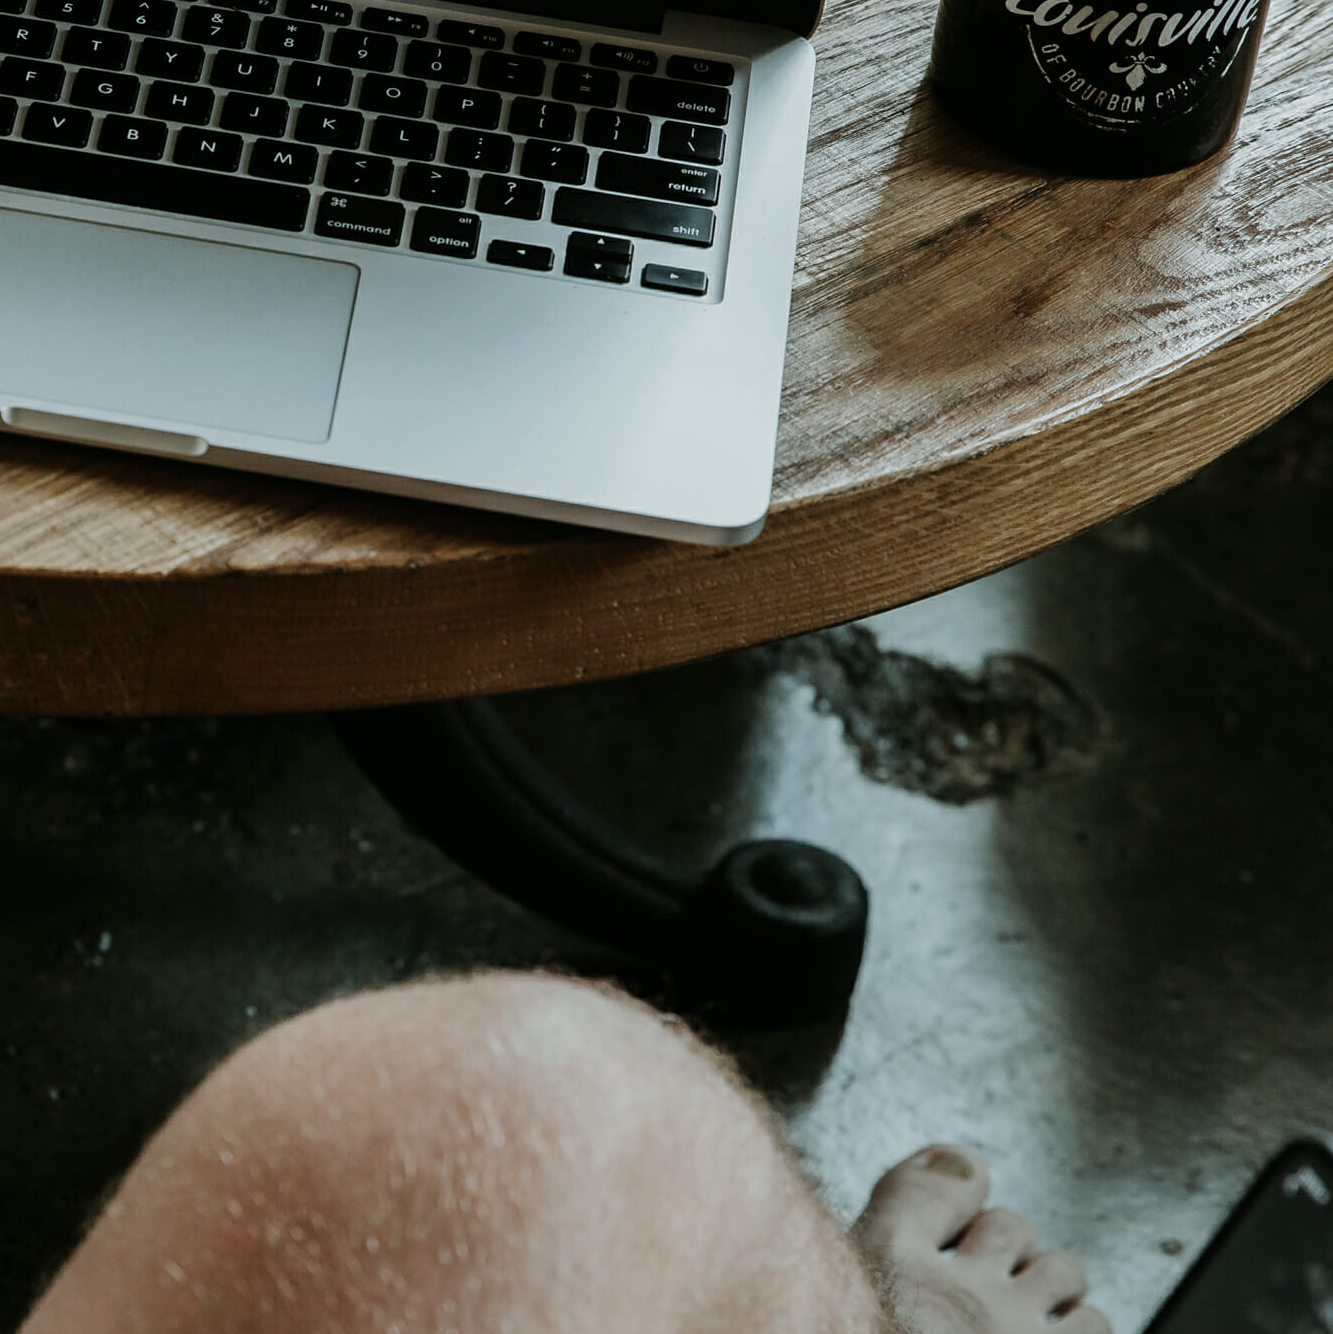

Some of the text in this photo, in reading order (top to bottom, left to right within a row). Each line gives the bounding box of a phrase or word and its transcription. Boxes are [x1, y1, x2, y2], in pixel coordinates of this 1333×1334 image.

[15, 27, 30, 41] R
[90, 38, 103, 52] T
[164, 50, 179, 64] Y
[24, 69, 38, 82] F
[236, 62, 254, 76] U
[1041, 42, 1067, 67] OF
[1058, 67, 1146, 114] BOURBON
[96, 81, 114, 95] G
[384, 86, 402, 99] O
[171, 93, 188, 107] H
[460, 97, 475, 110] P
[675, 100, 717, 114] delete
[248, 105, 260, 118] J
[321, 116, 337, 131] K
[398, 129, 410, 142] L
[680, 167, 709, 178] enter
[667, 181, 709, 198] return
[325, 219, 392, 236] command
[671, 224, 701, 238] shift
[427, 234, 470, 249] option
